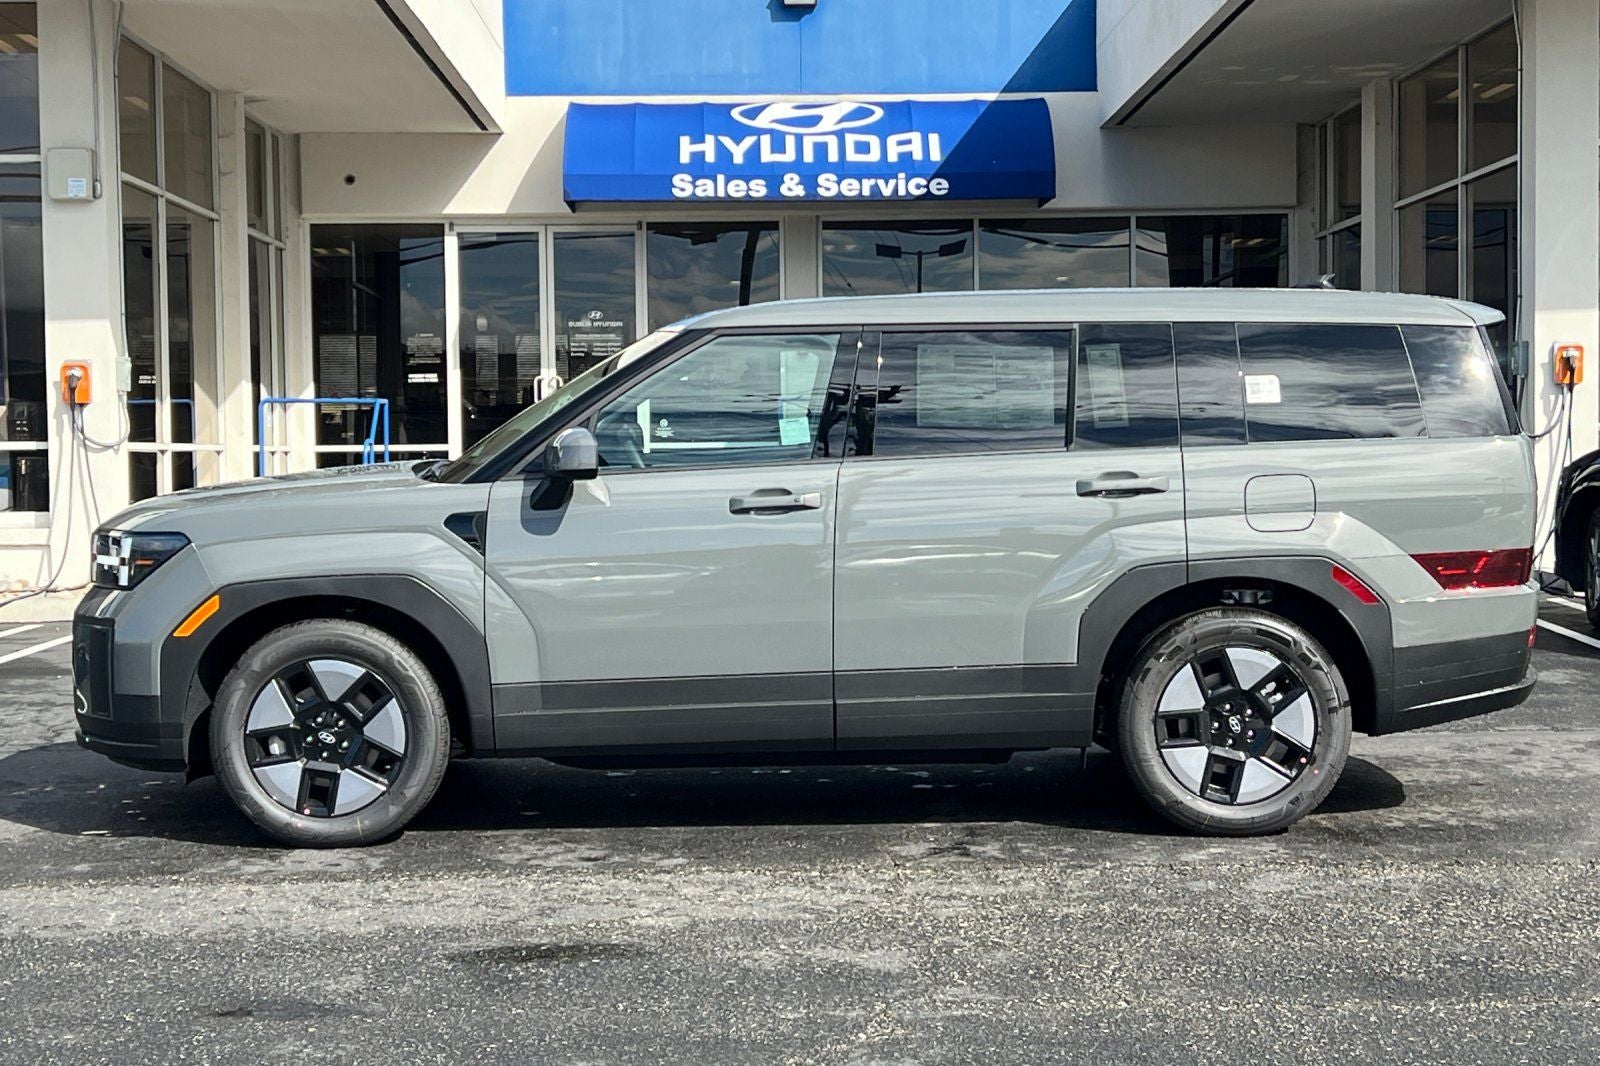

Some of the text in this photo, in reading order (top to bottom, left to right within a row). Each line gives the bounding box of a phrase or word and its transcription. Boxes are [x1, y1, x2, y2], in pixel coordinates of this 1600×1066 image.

[679, 131, 941, 164] HYUNDAI
[671, 172, 950, 197] Sales & Service
